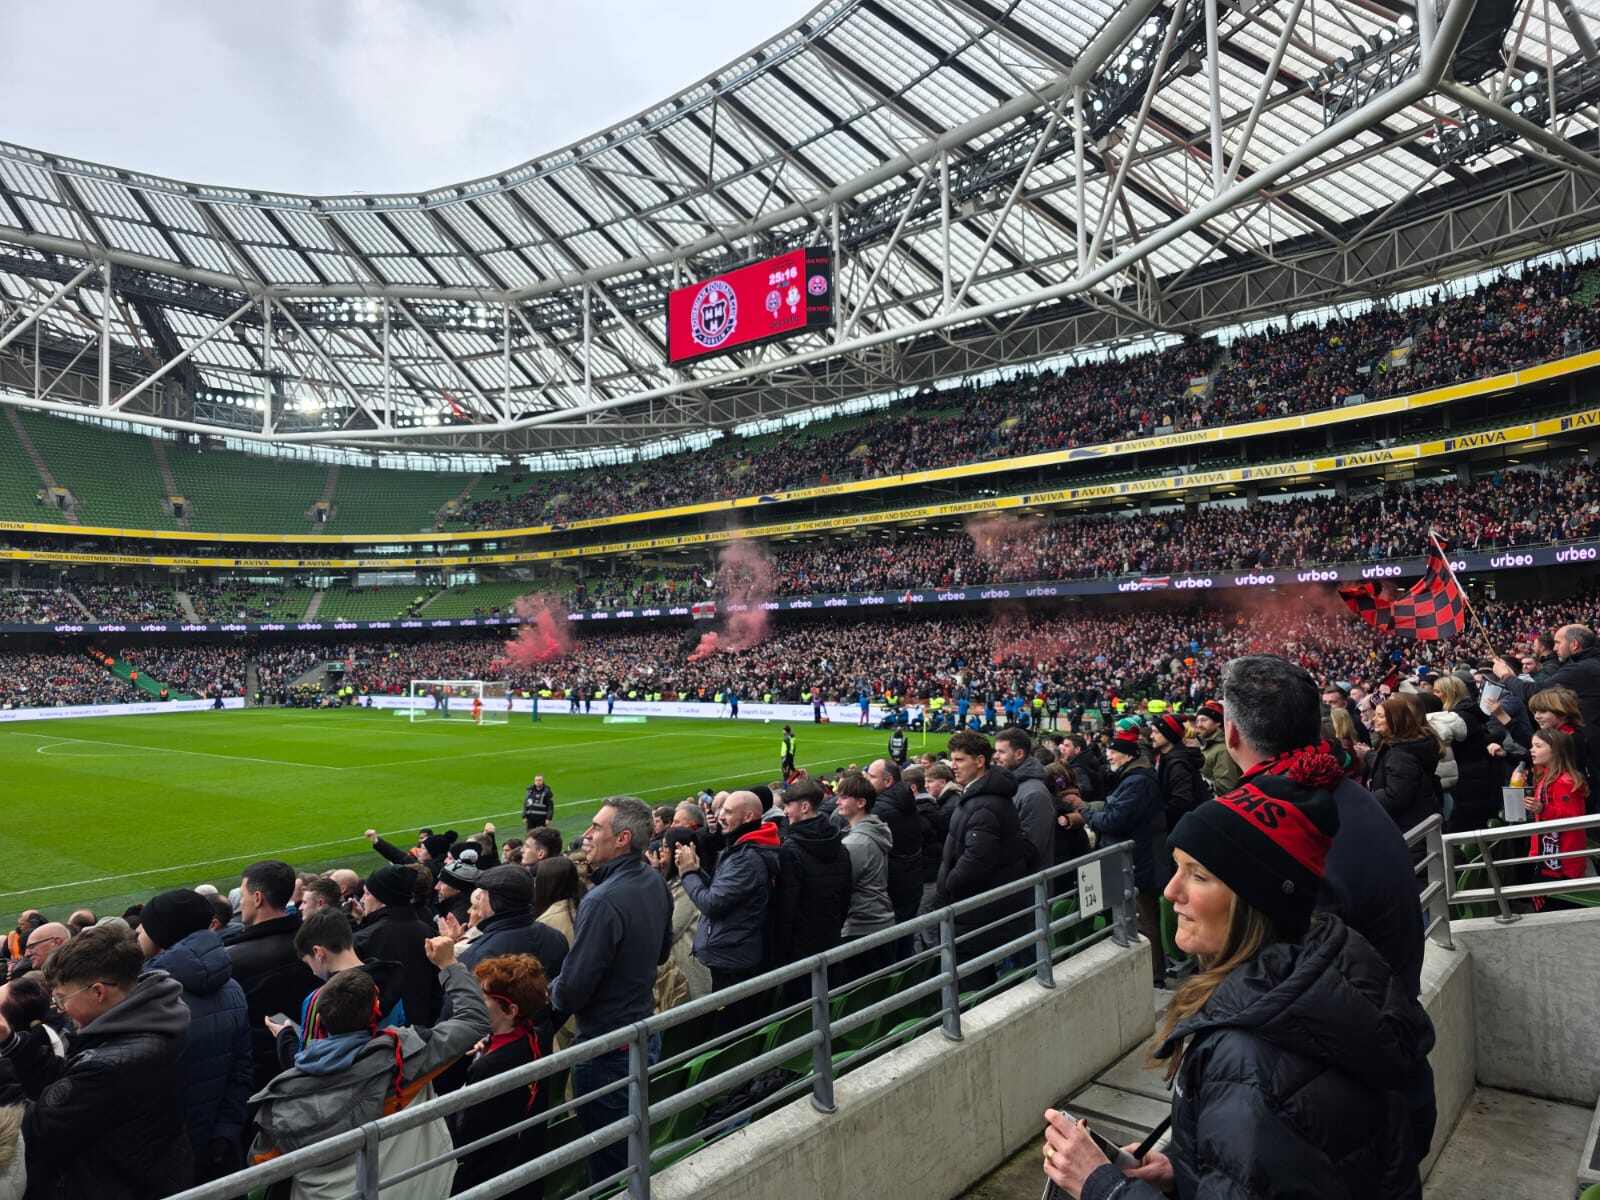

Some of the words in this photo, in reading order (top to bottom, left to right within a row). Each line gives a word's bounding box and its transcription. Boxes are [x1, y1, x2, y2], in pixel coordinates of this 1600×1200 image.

[1124, 439, 1157, 450] AVIVA
[1159, 432, 1209, 446] STADIUM
[1459, 431, 1506, 448] AVIVA
[1349, 450, 1393, 466] AVIVA
[1255, 464, 1297, 477] AVIVA
[1186, 473, 1224, 485] AVIVA
[1132, 480, 1168, 491] AVIVA
[1031, 491, 1064, 503] AVIVA
[1081, 486, 1115, 497] AVIVA
[1556, 547, 1596, 562] urbeo
[242, 559, 270, 567] AVIVA
[1491, 554, 1533, 567] urbeo
[1298, 570, 1338, 582] urbeo
[1362, 565, 1401, 578] urbeo
[1175, 578, 1212, 590] urbeo
[1235, 574, 1275, 586] urbeo
[938, 592, 965, 601] urbeo
[981, 589, 1010, 599] urbeo
[1026, 586, 1056, 597] urbeo
[758, 602, 779, 610] urbeo
[790, 600, 812, 609] urbeo
[824, 598, 847, 607] urbeo
[860, 596, 884, 605] urbeo
[55, 624, 83, 632] urbeo
[99, 624, 126, 632] urbeo
[260, 623, 285, 631] urbeo
[298, 622, 322, 630] urbeo
[369, 621, 391, 629] urbeo
